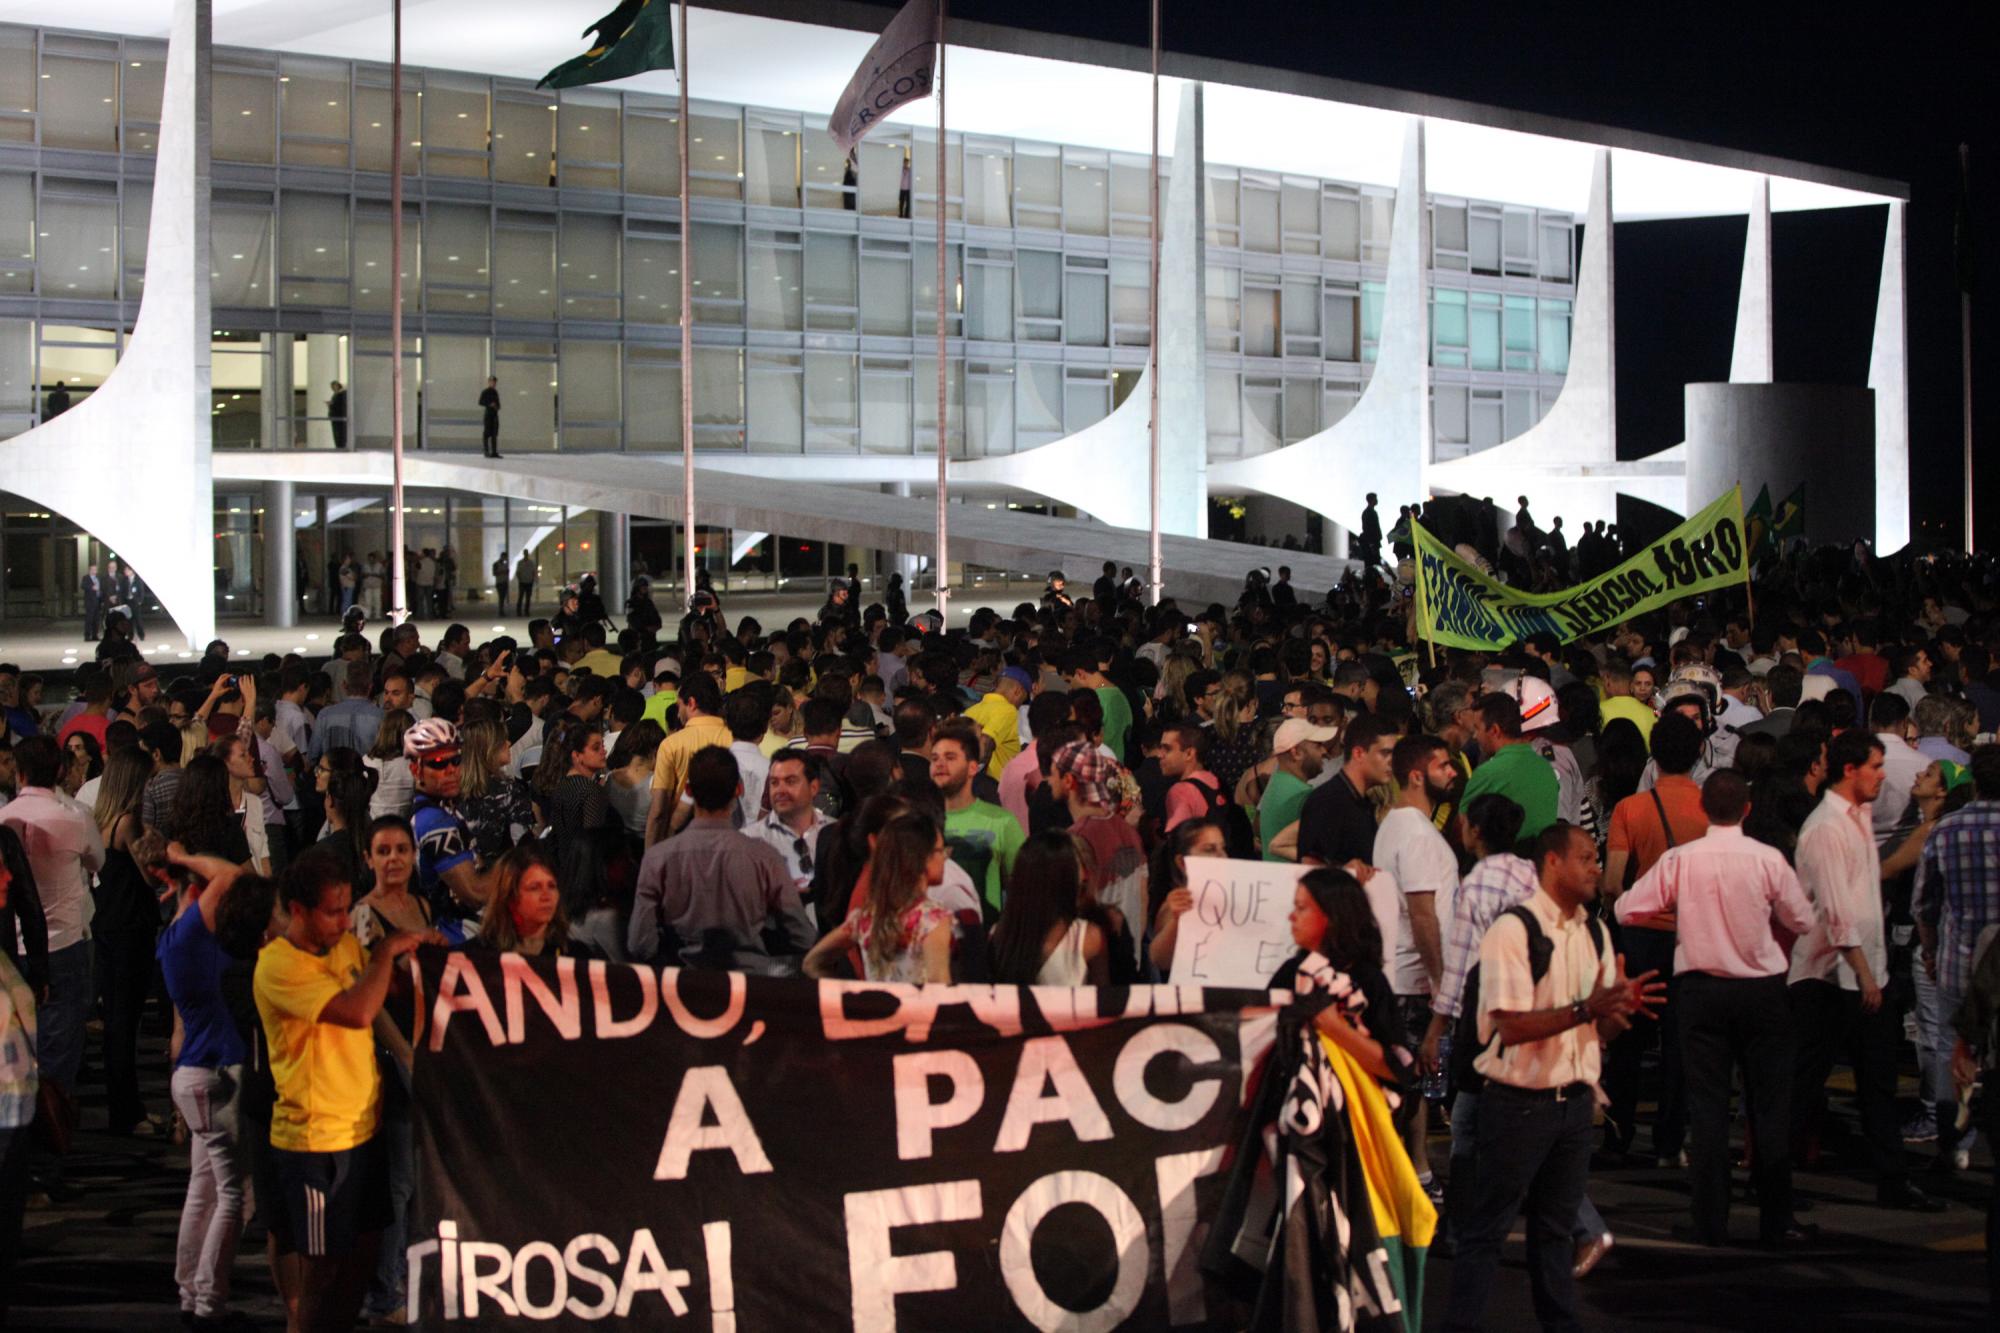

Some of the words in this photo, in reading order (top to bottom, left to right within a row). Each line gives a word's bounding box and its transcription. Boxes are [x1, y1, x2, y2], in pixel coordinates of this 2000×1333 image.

[1198, 879, 1272, 930] QUE
[410, 951, 767, 1052] ANDO,
[653, 1065, 774, 1181] A
